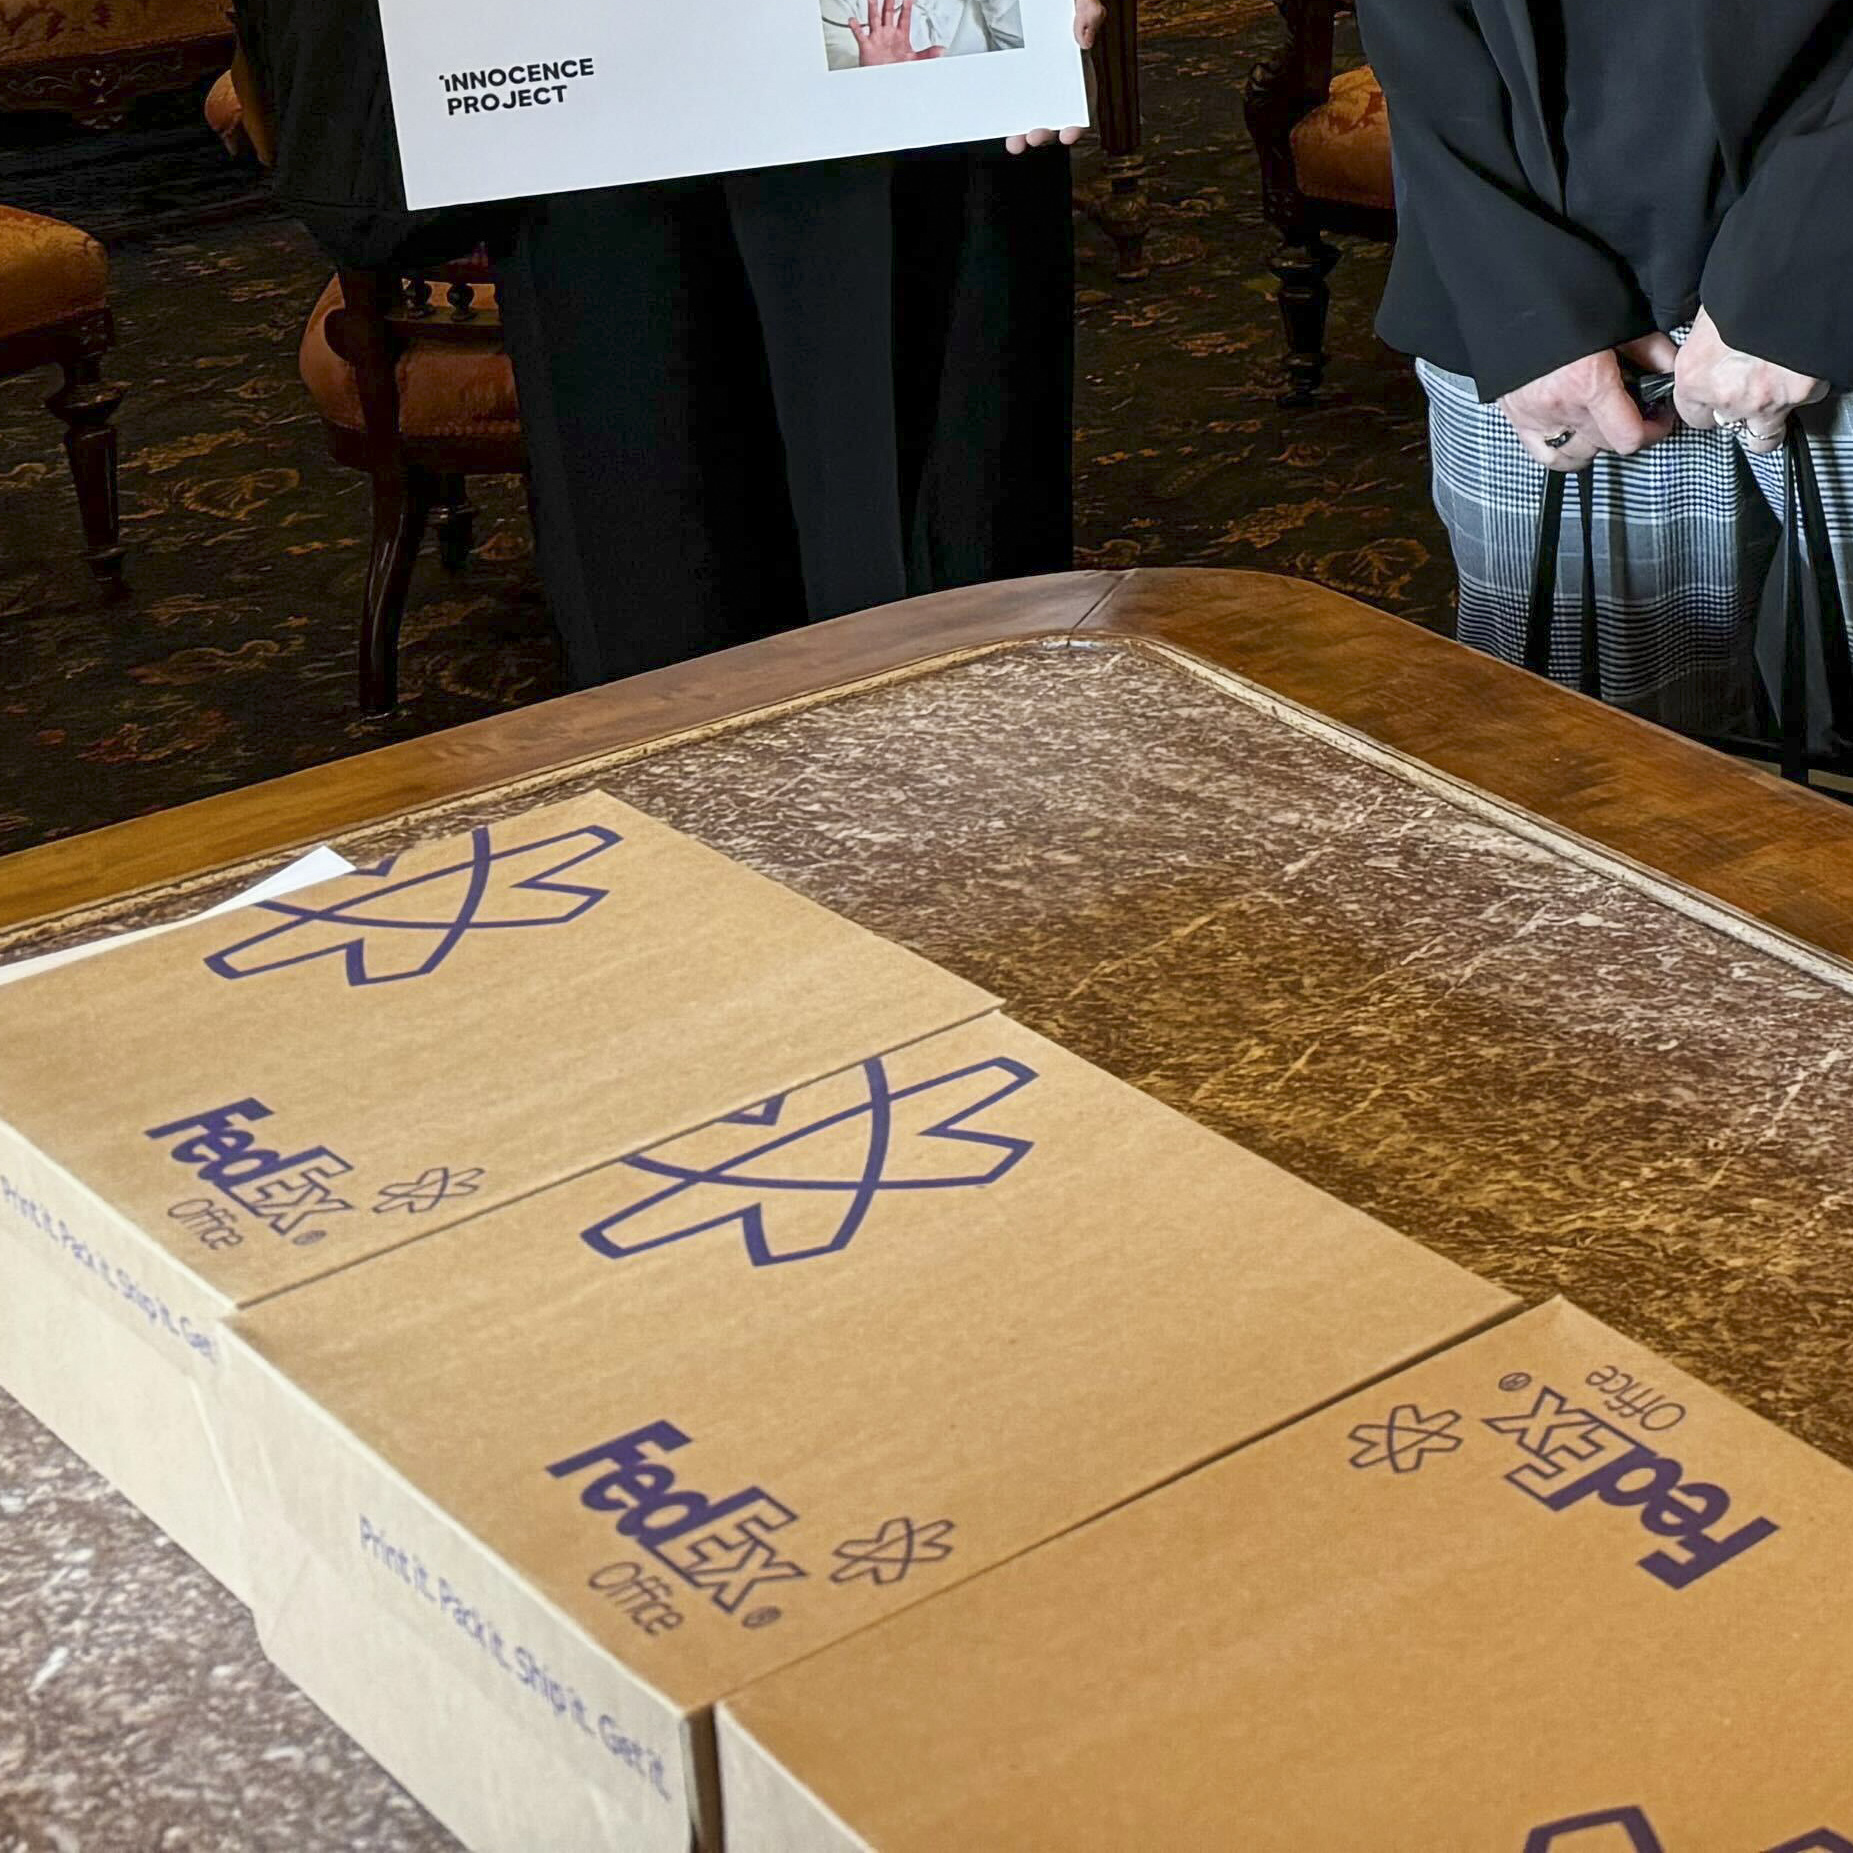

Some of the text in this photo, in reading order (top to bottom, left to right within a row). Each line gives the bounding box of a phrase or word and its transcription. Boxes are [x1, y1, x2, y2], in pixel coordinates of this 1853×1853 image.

[447, 85, 568, 116] PROJECT
[167, 1198, 244, 1250] Office
[1585, 1365, 1686, 1431] Office
[360, 1512, 411, 1585] Print
[439, 1576, 487, 1650] Pack
[515, 1646, 567, 1717] Ship
[588, 1561, 684, 1636] Office
